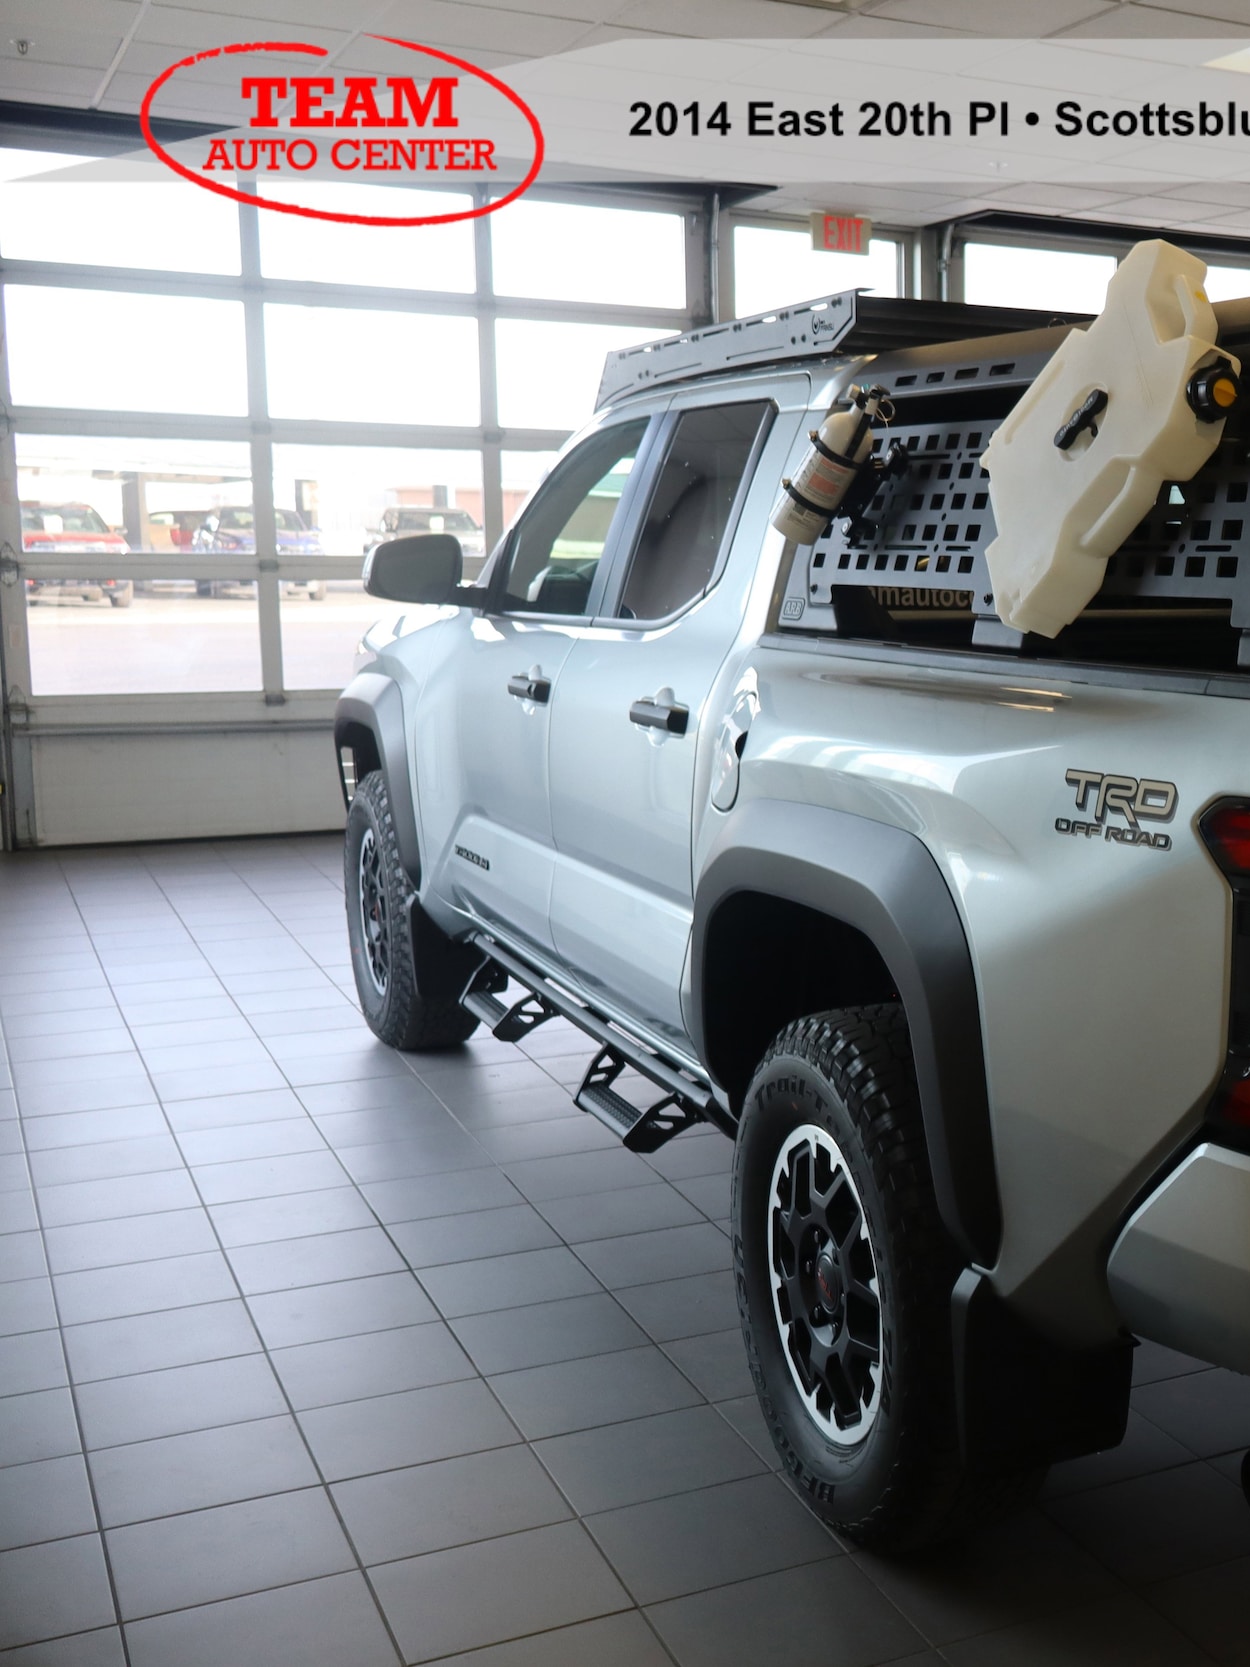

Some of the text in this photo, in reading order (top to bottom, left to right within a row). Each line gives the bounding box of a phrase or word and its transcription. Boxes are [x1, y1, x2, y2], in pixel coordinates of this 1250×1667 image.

[823, 215, 864, 253] EXIT
[1065, 768, 1179, 834] TRD
[1055, 817, 1173, 852] OFF ROAD
